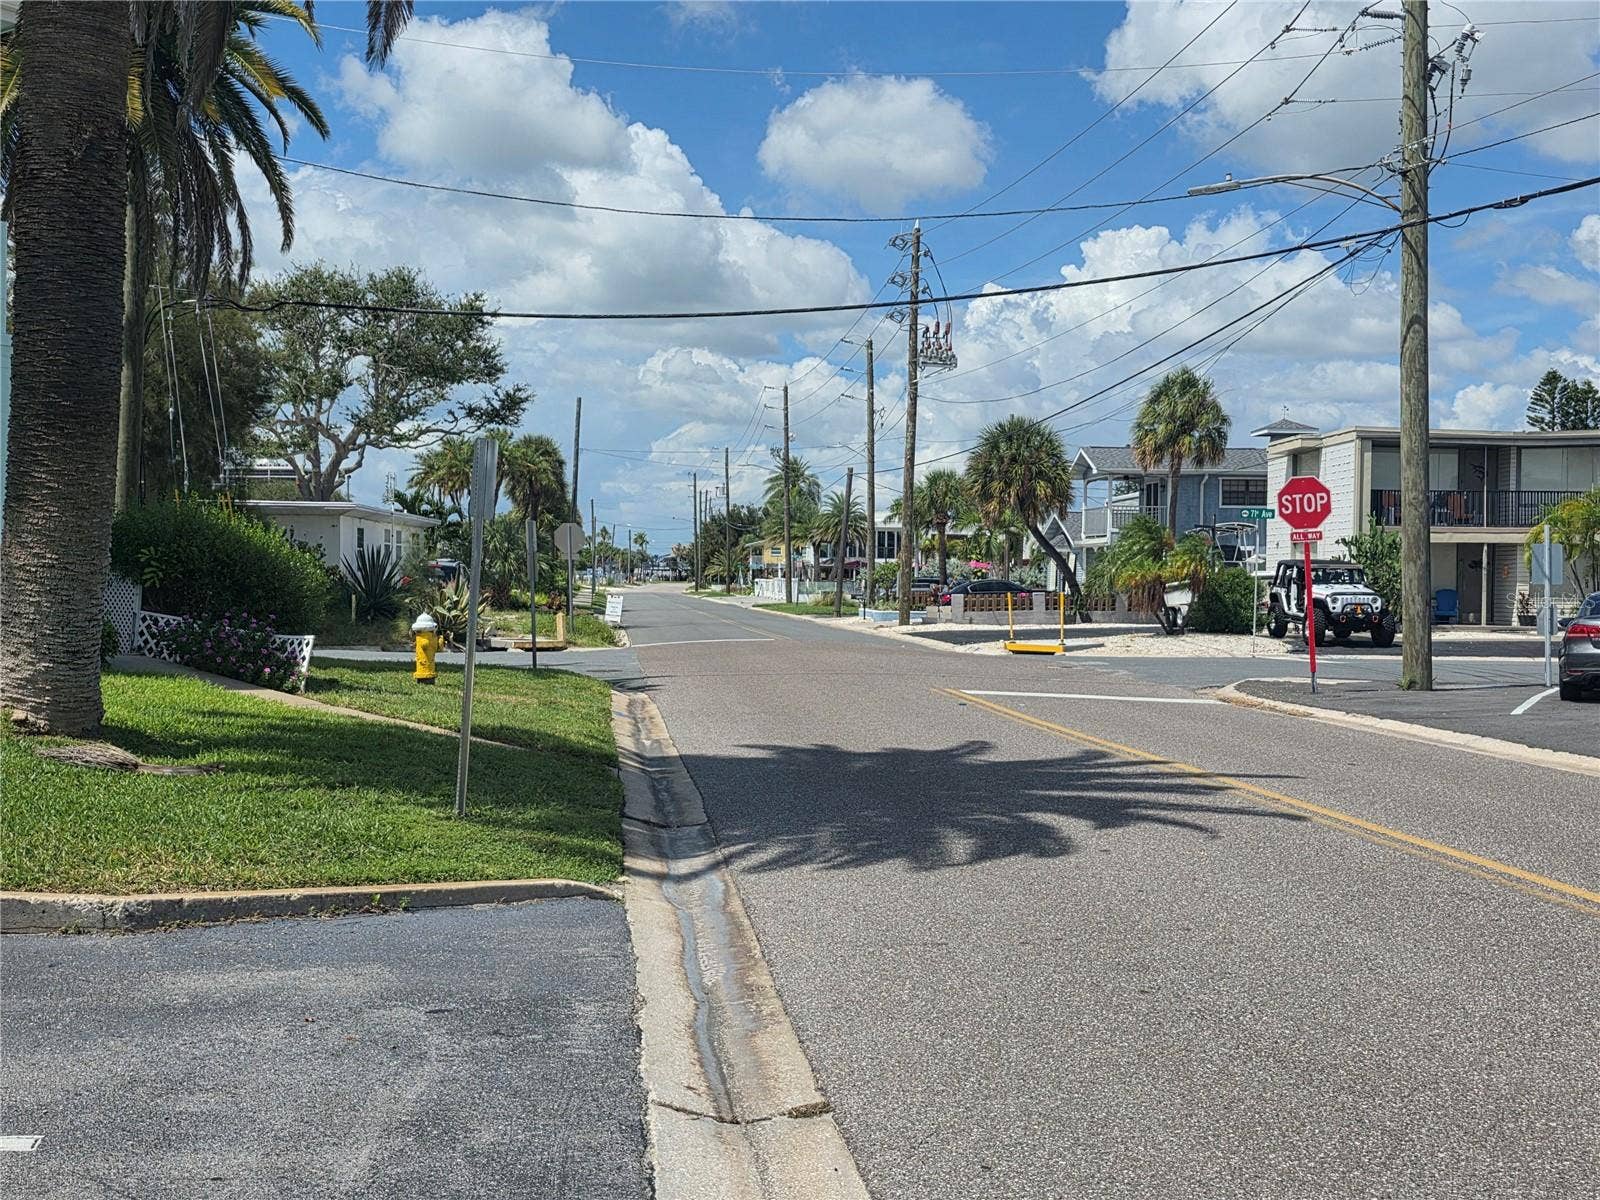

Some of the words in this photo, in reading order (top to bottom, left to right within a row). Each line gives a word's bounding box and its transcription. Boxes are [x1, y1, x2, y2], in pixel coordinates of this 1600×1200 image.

[1281, 492, 1328, 514] STOP
[1261, 509, 1273, 518] Ave
[1292, 533, 1305, 541] ALL
[1307, 532, 1321, 540] WAY
